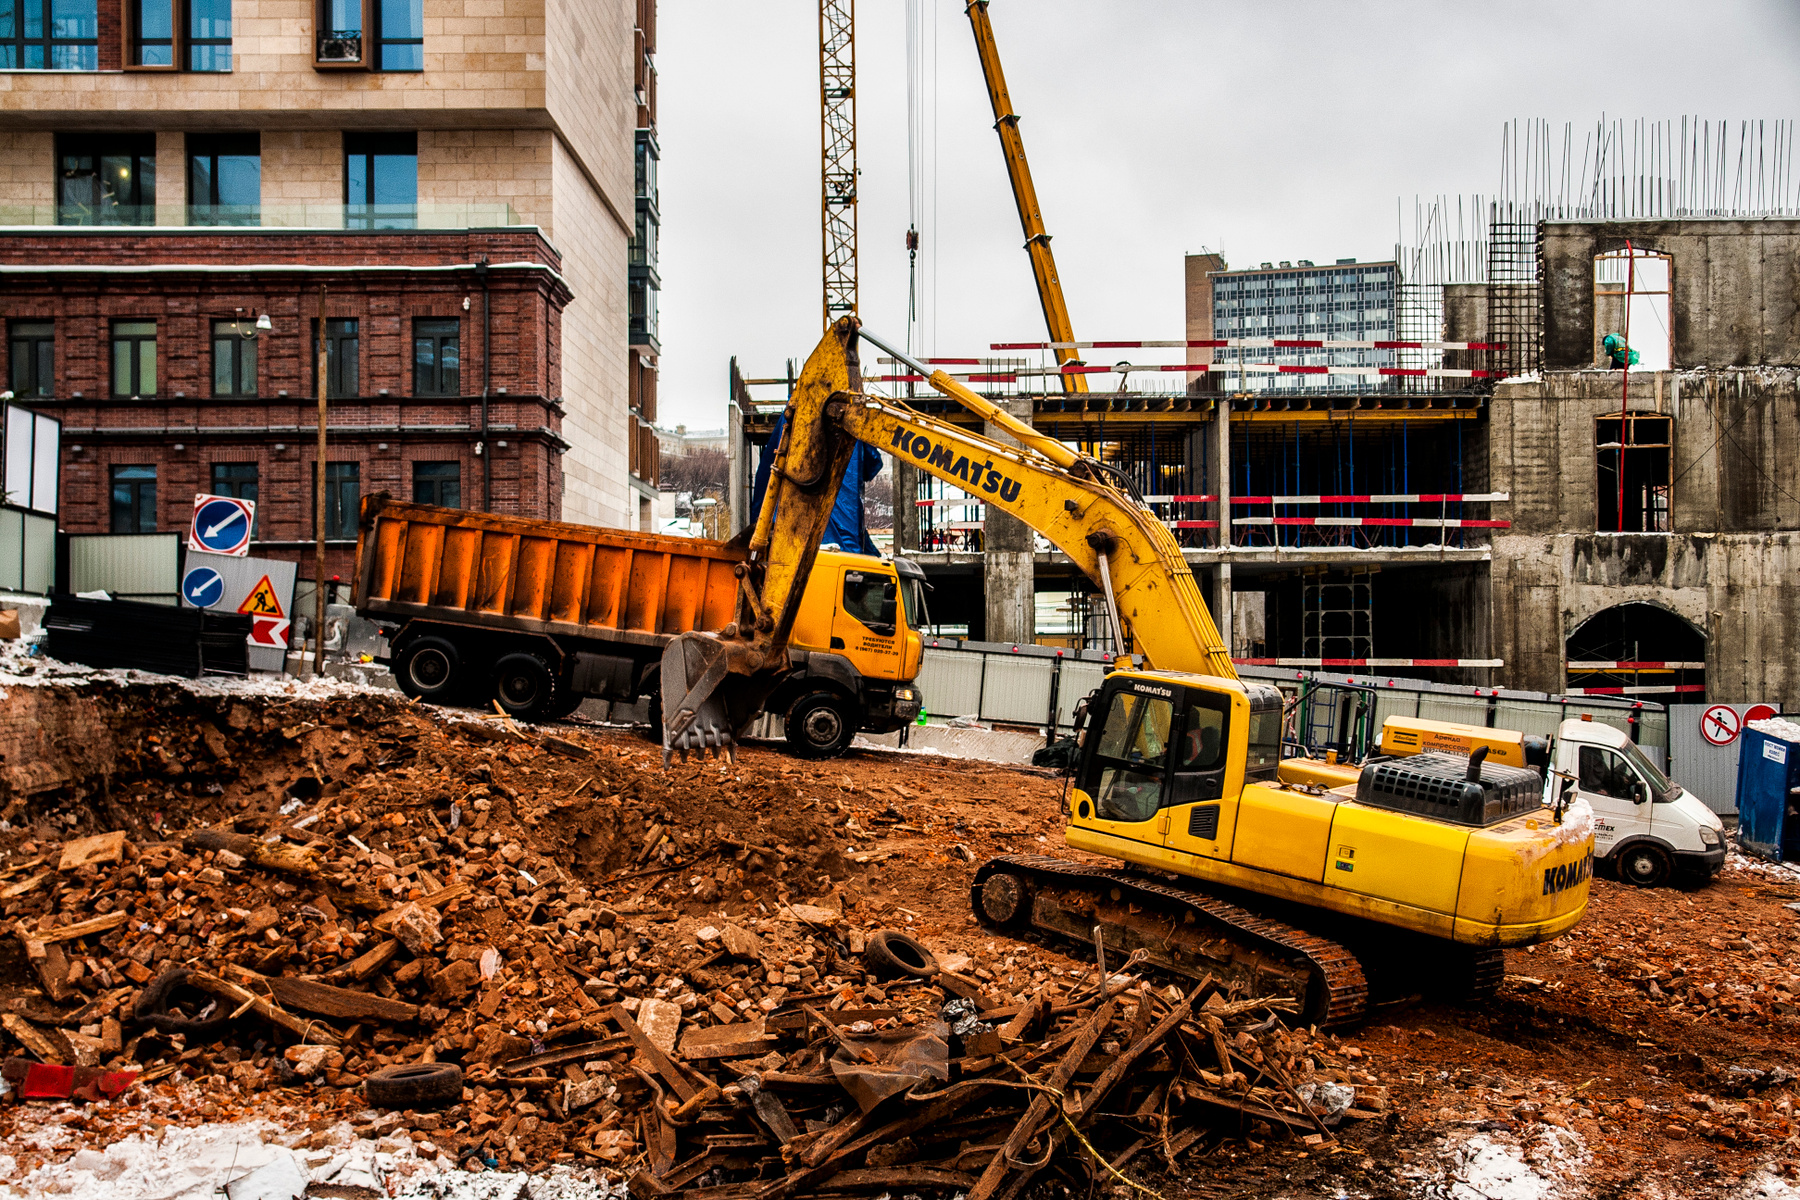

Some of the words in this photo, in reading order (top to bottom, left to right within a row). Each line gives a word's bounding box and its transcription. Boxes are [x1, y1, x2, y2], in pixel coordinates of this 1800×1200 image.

[891, 425, 1022, 503] KOMATSU
[862, 636, 895, 644] ТРЕБУЮТСЯ
[1133, 683, 1172, 697] KOMATSU
[1434, 733, 1461, 743] Аренда
[1542, 846, 1594, 896] KOMATS
